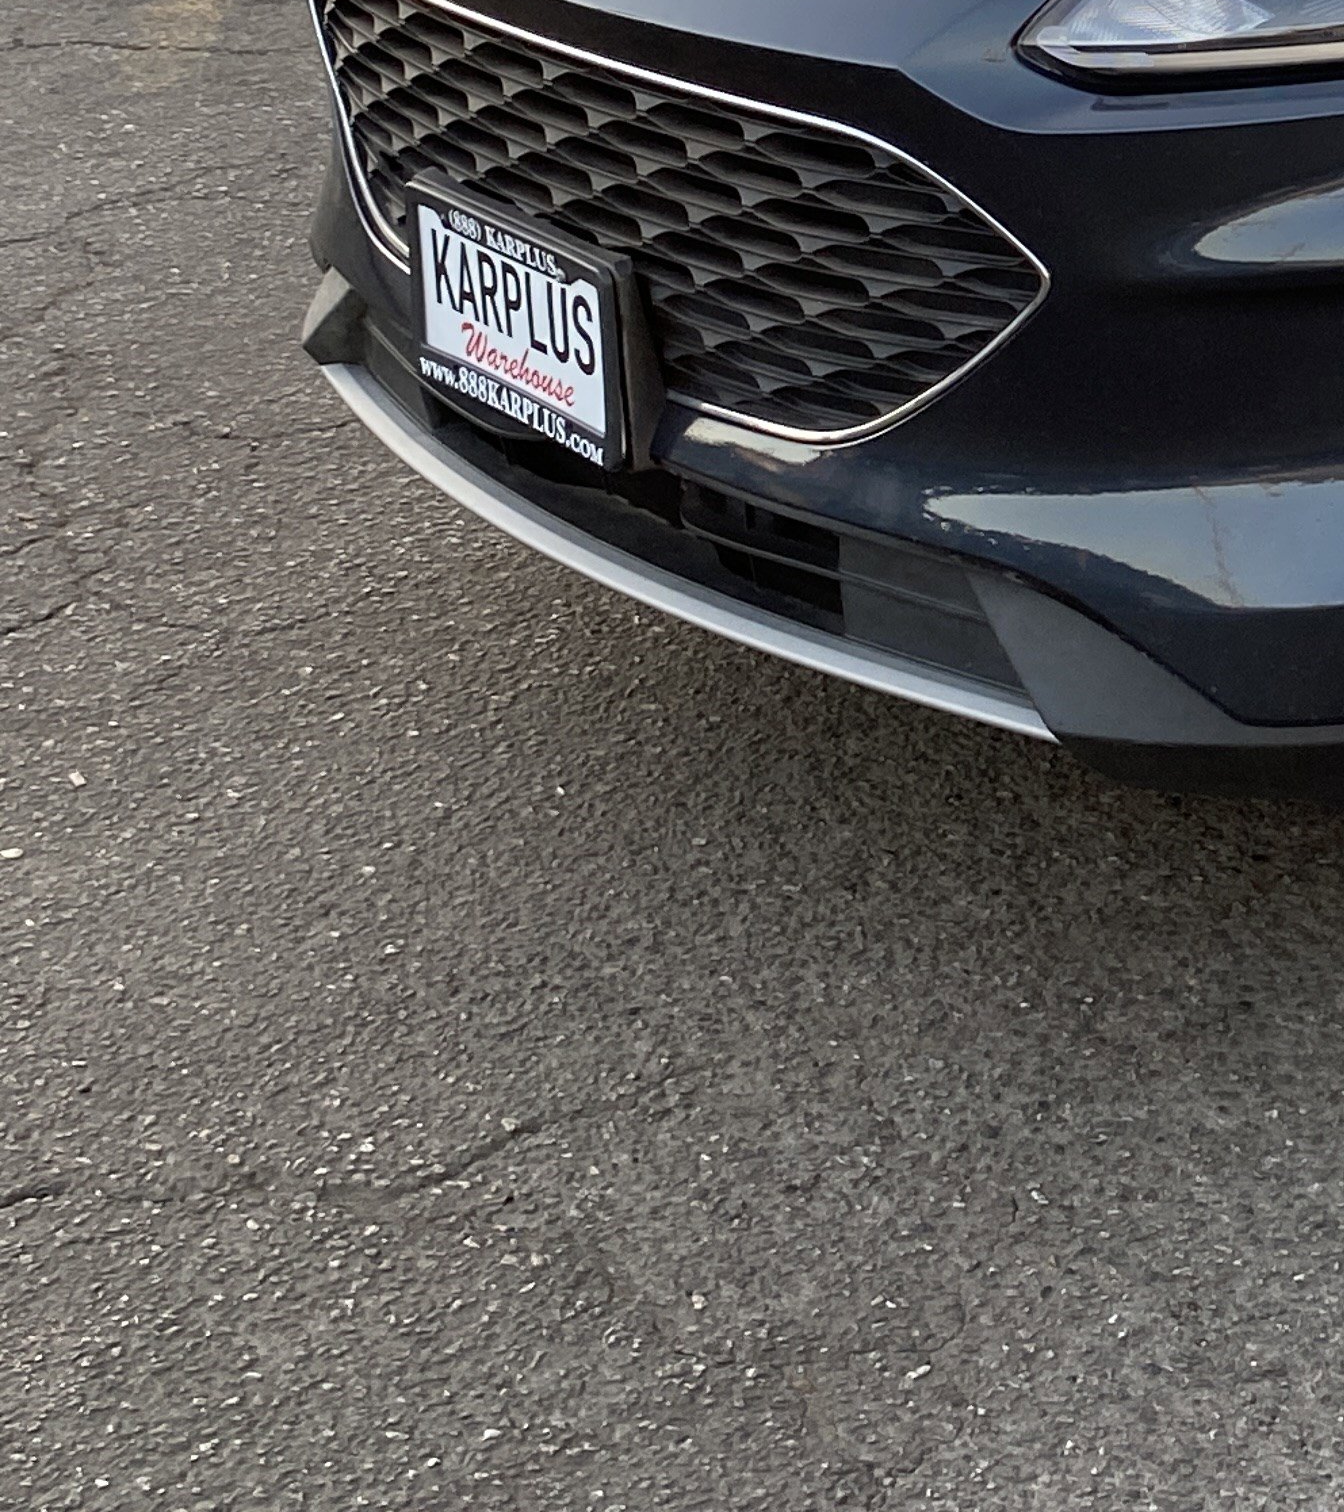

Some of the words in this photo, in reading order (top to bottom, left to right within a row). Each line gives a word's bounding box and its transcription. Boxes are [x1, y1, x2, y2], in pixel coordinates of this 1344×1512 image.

[448, 209, 482, 241] (888)
[484, 225, 557, 276] KARPLUS
[431, 228, 596, 376] KARPLUS
[461, 322, 576, 407] Warehouse
